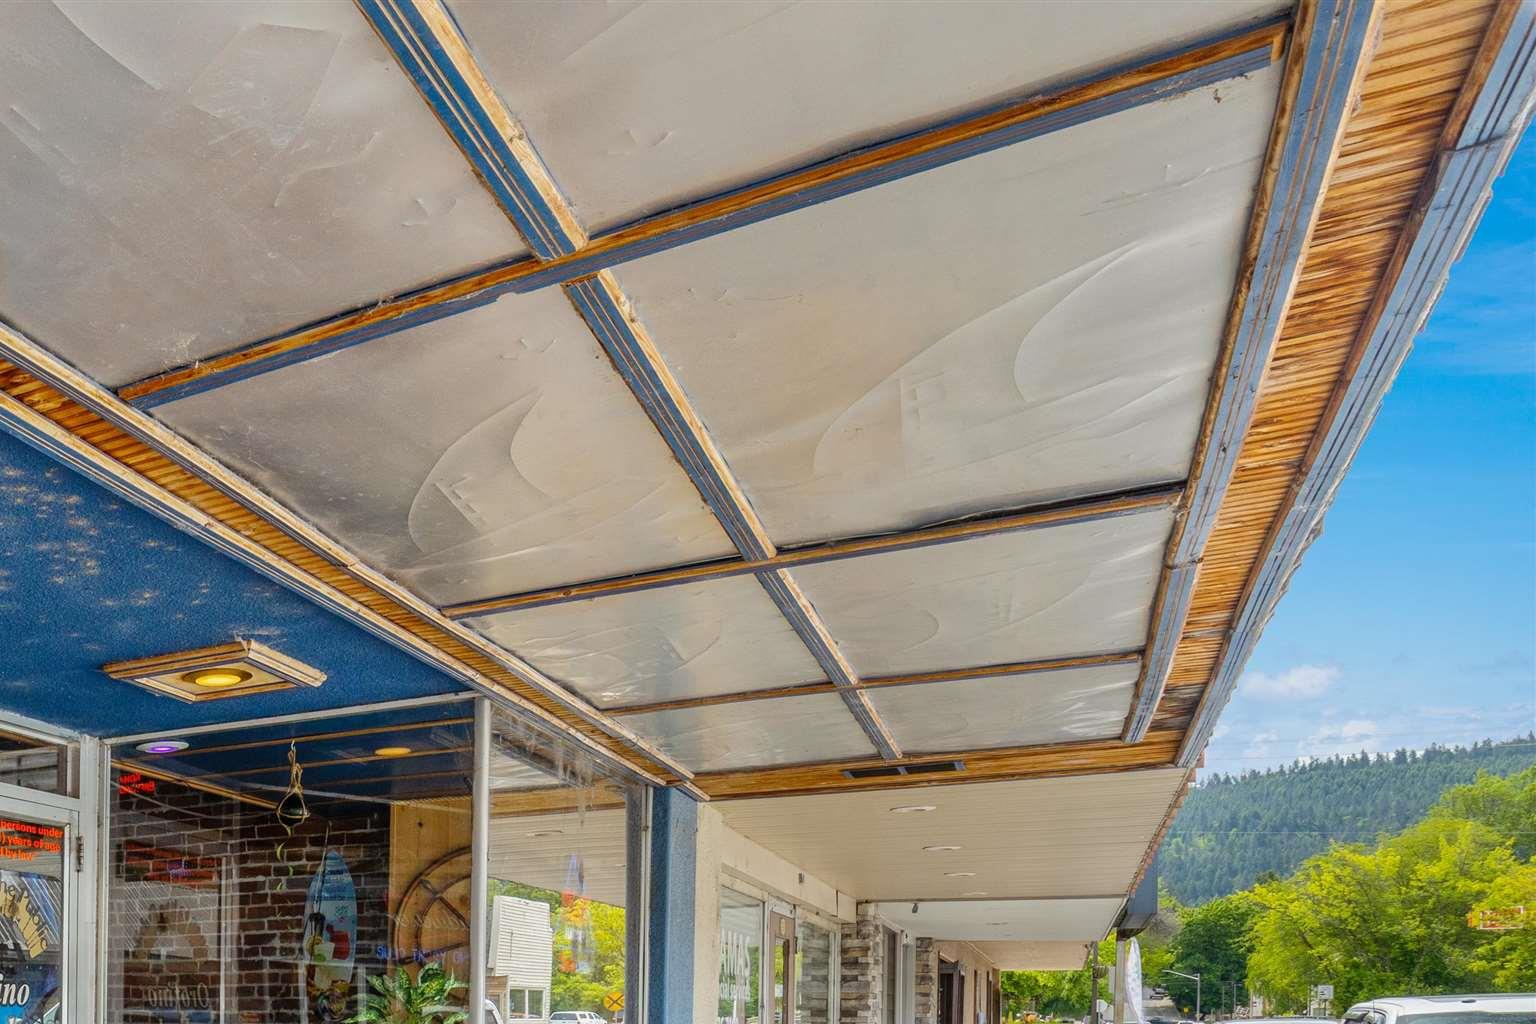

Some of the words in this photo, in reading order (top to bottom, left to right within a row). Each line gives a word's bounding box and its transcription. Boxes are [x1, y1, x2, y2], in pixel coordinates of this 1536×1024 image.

[0, 820, 37, 834] persons
[38, 824, 64, 838] under
[7, 834, 32, 848] years
[33, 838, 44, 848] of
[5, 847, 17, 859] by
